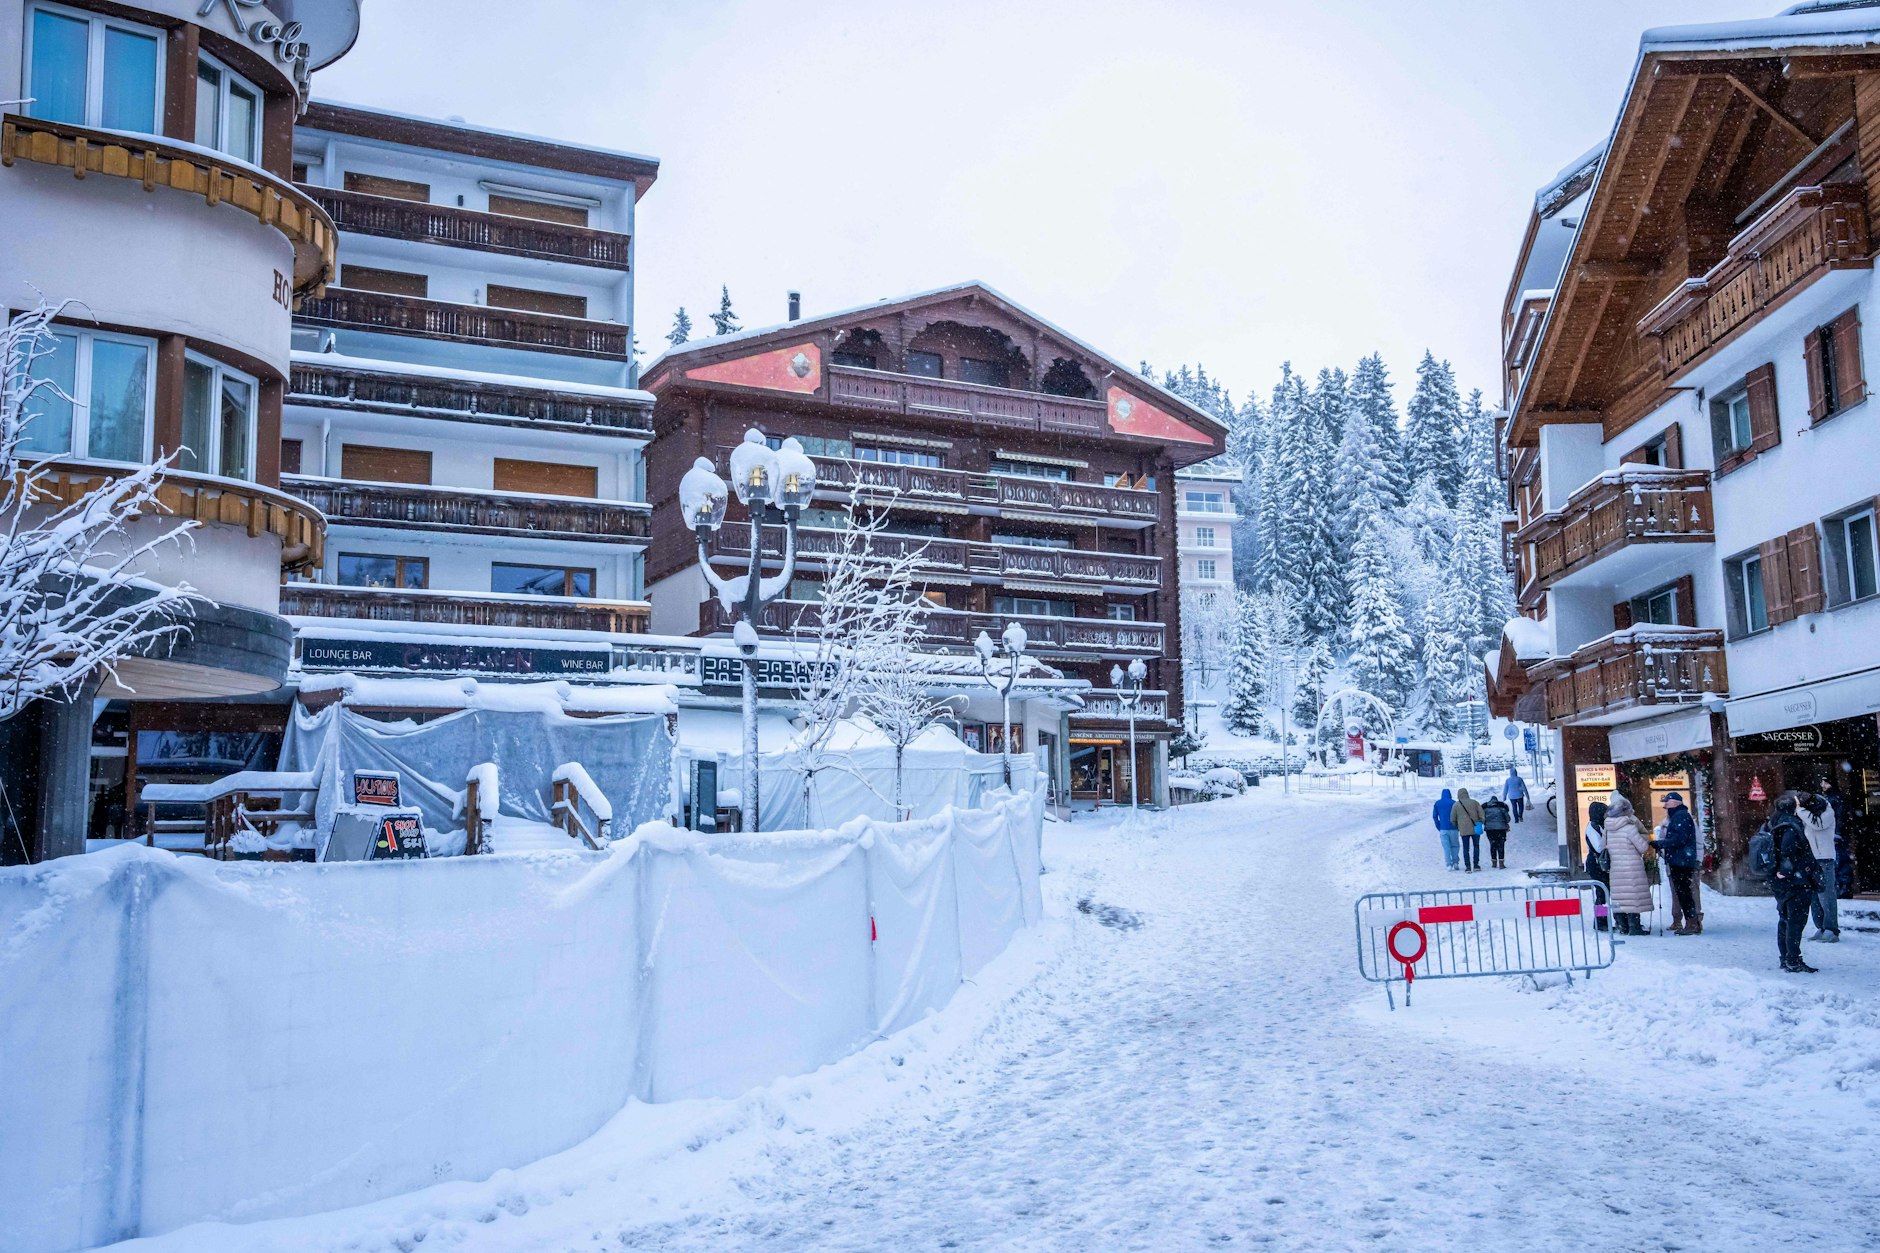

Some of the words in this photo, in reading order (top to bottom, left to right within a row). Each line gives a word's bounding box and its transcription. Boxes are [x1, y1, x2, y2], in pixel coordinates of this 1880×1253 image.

[272, 268, 293, 316] HO
[309, 648, 350, 660] LOUNGE
[352, 650, 372, 661] BAR
[561, 658, 584, 669] WINE
[586, 660, 604, 670] BAR
[1761, 731, 1814, 742] SAEGESSER
[403, 838, 422, 848] SKI
